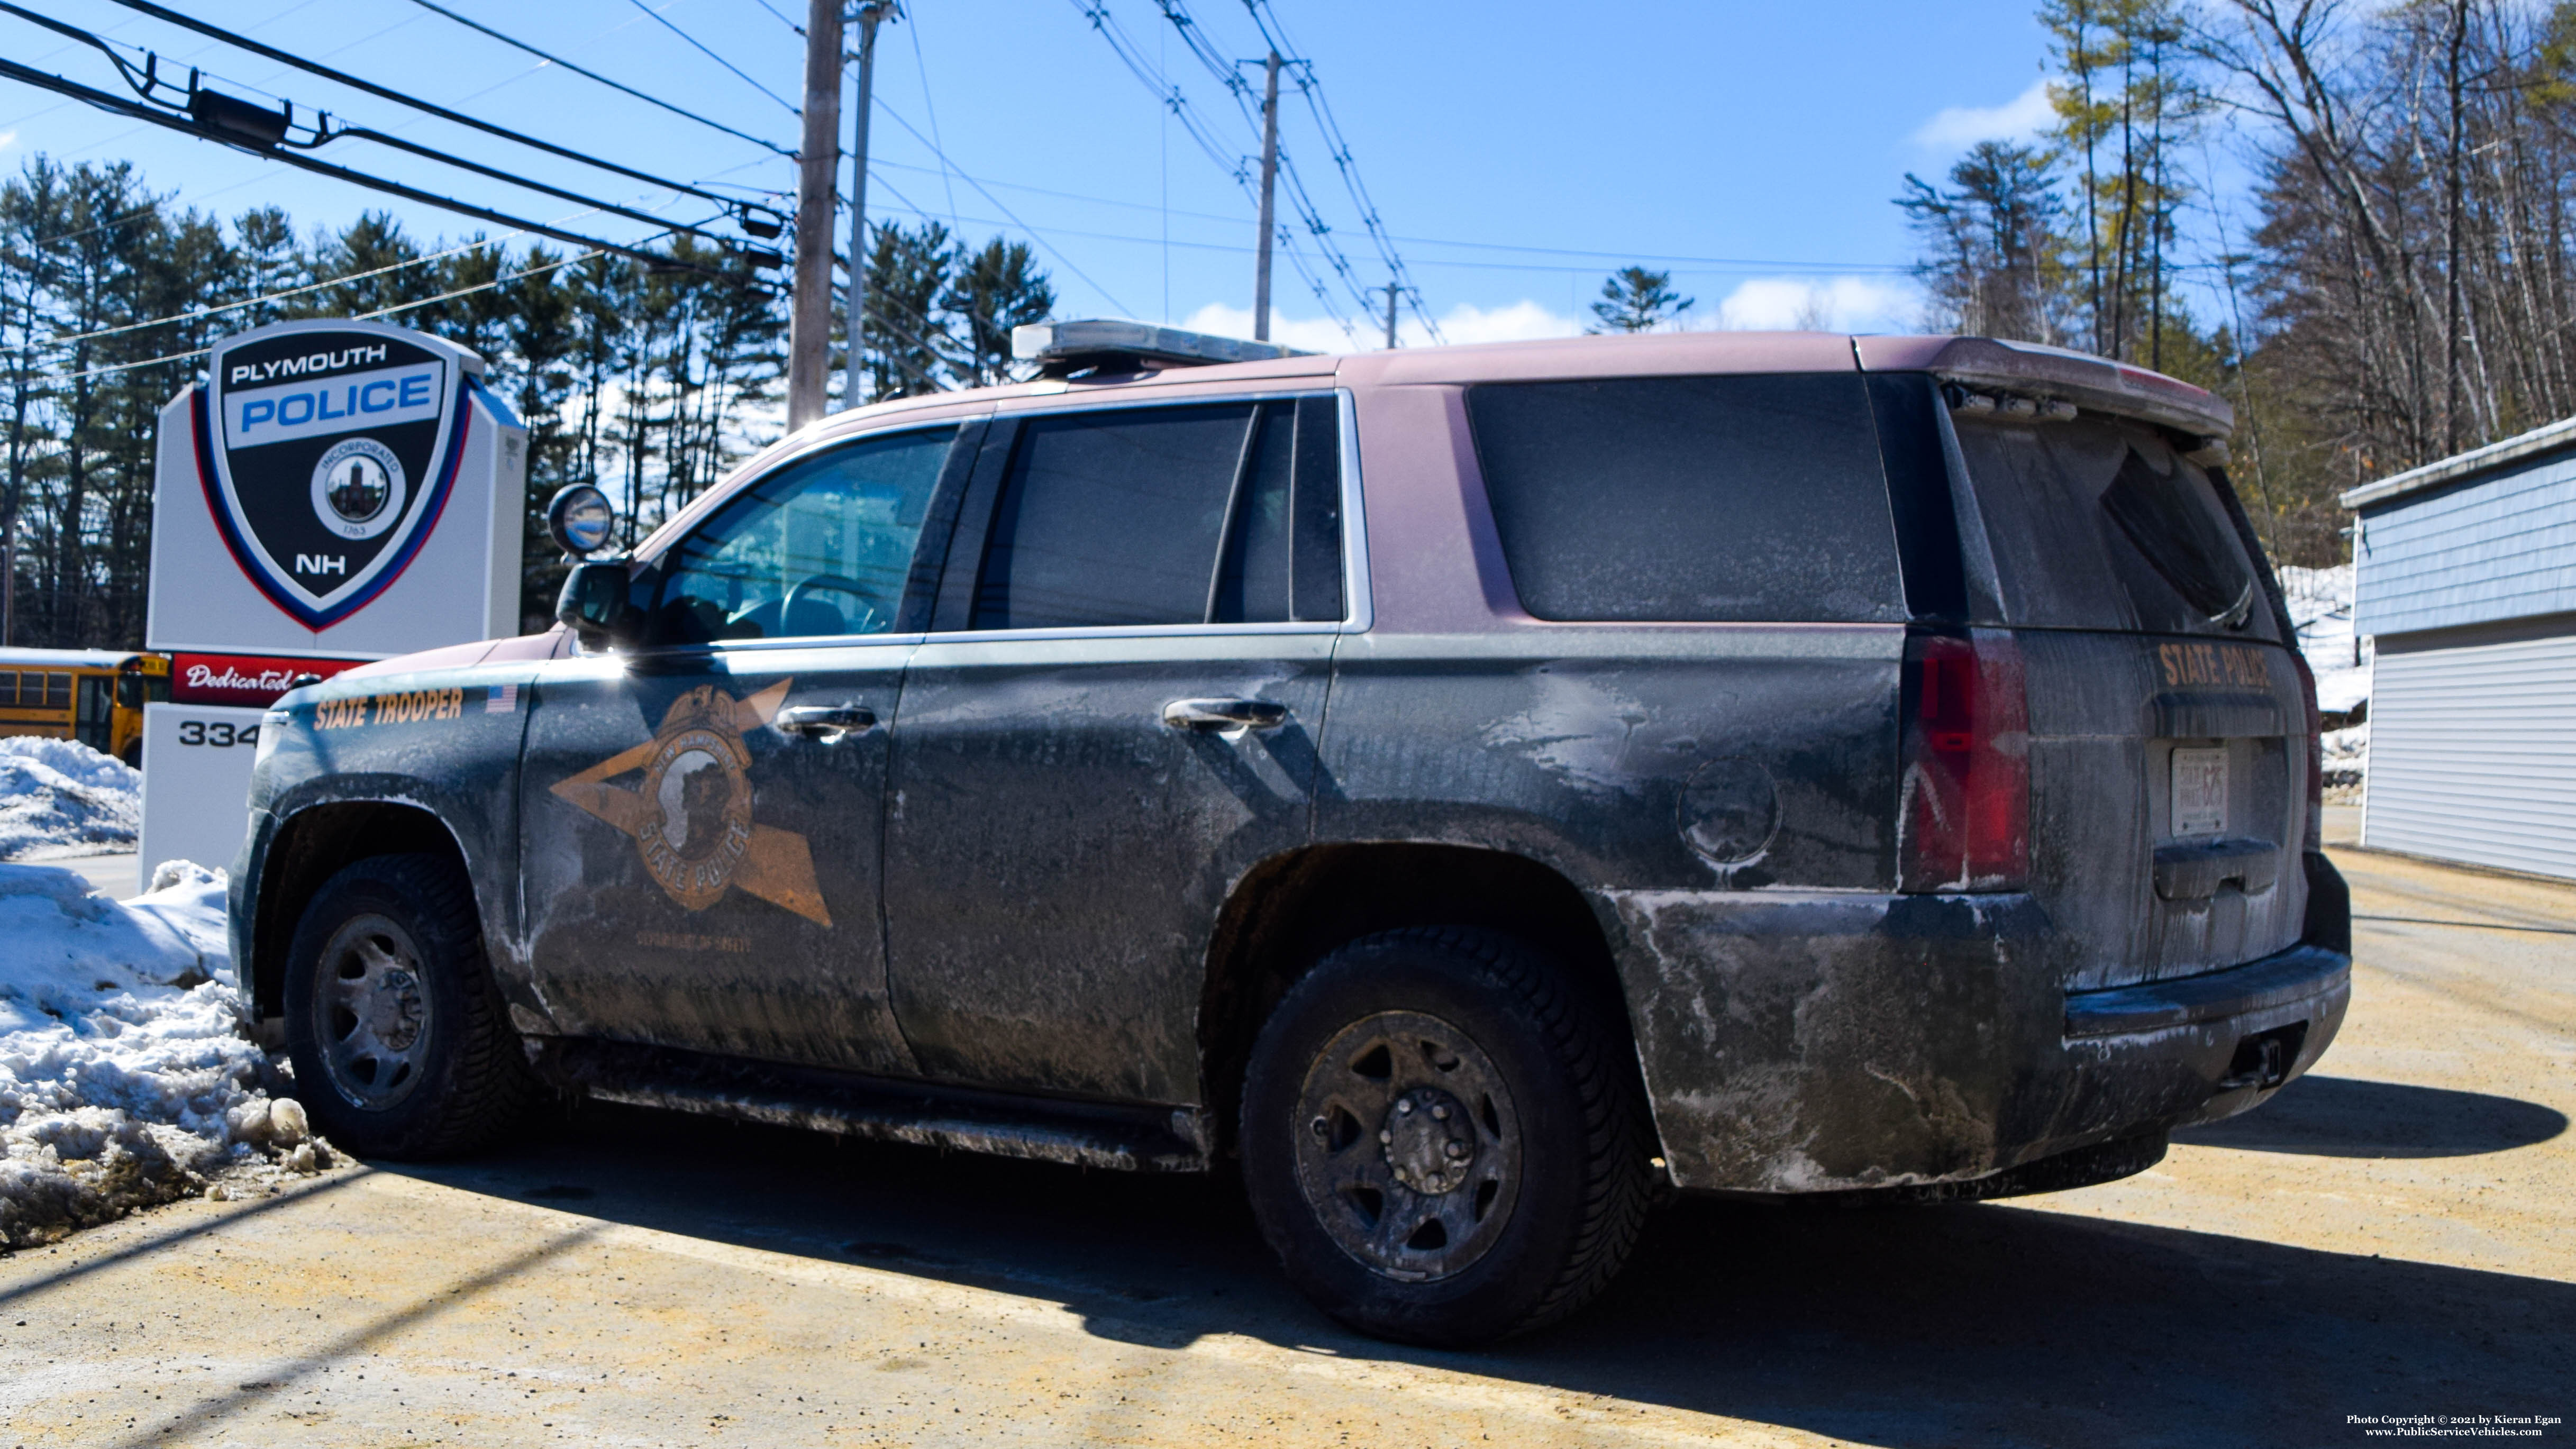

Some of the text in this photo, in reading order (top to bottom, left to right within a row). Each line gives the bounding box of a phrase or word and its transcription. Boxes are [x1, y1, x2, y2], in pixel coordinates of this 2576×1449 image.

[232, 343, 387, 385] PLYMOUTH
[241, 373, 432, 433] POLICE
[322, 441, 399, 473] INCORPORATED
[344, 524, 367, 536] 1763
[296, 553, 345, 575] NH
[186, 664, 293, 691] Dedicated
[2159, 643, 2272, 688] STATE POLICE
[313, 687, 463, 731] STATE TROOPER
[179, 720, 261, 749] 334
[654, 743, 676, 773] NEW
[639, 818, 751, 893] STATE POLICE
